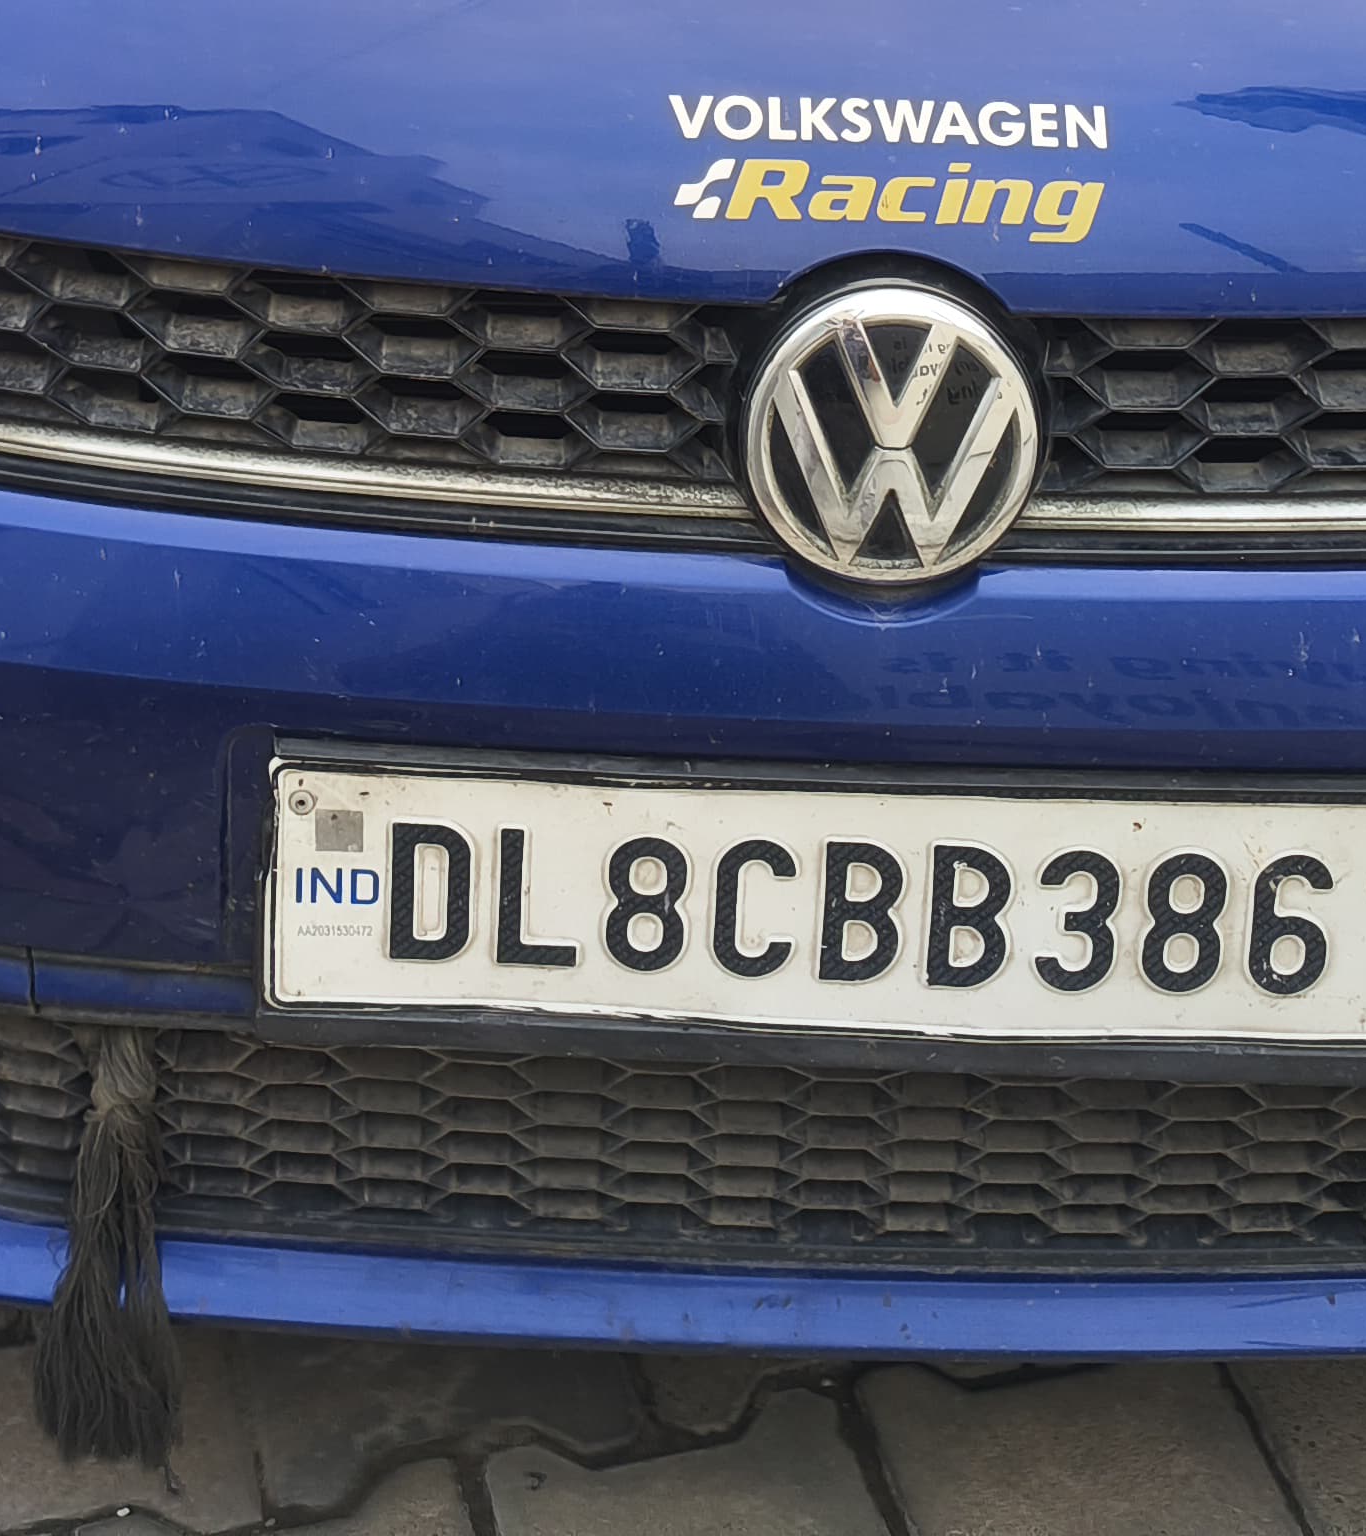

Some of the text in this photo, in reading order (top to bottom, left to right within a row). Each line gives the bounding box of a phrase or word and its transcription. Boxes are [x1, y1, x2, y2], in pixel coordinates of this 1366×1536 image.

[668, 94, 1109, 150] VOLKSWAGEN
[724, 157, 1106, 244] Racing
[295, 866, 380, 906] IND
